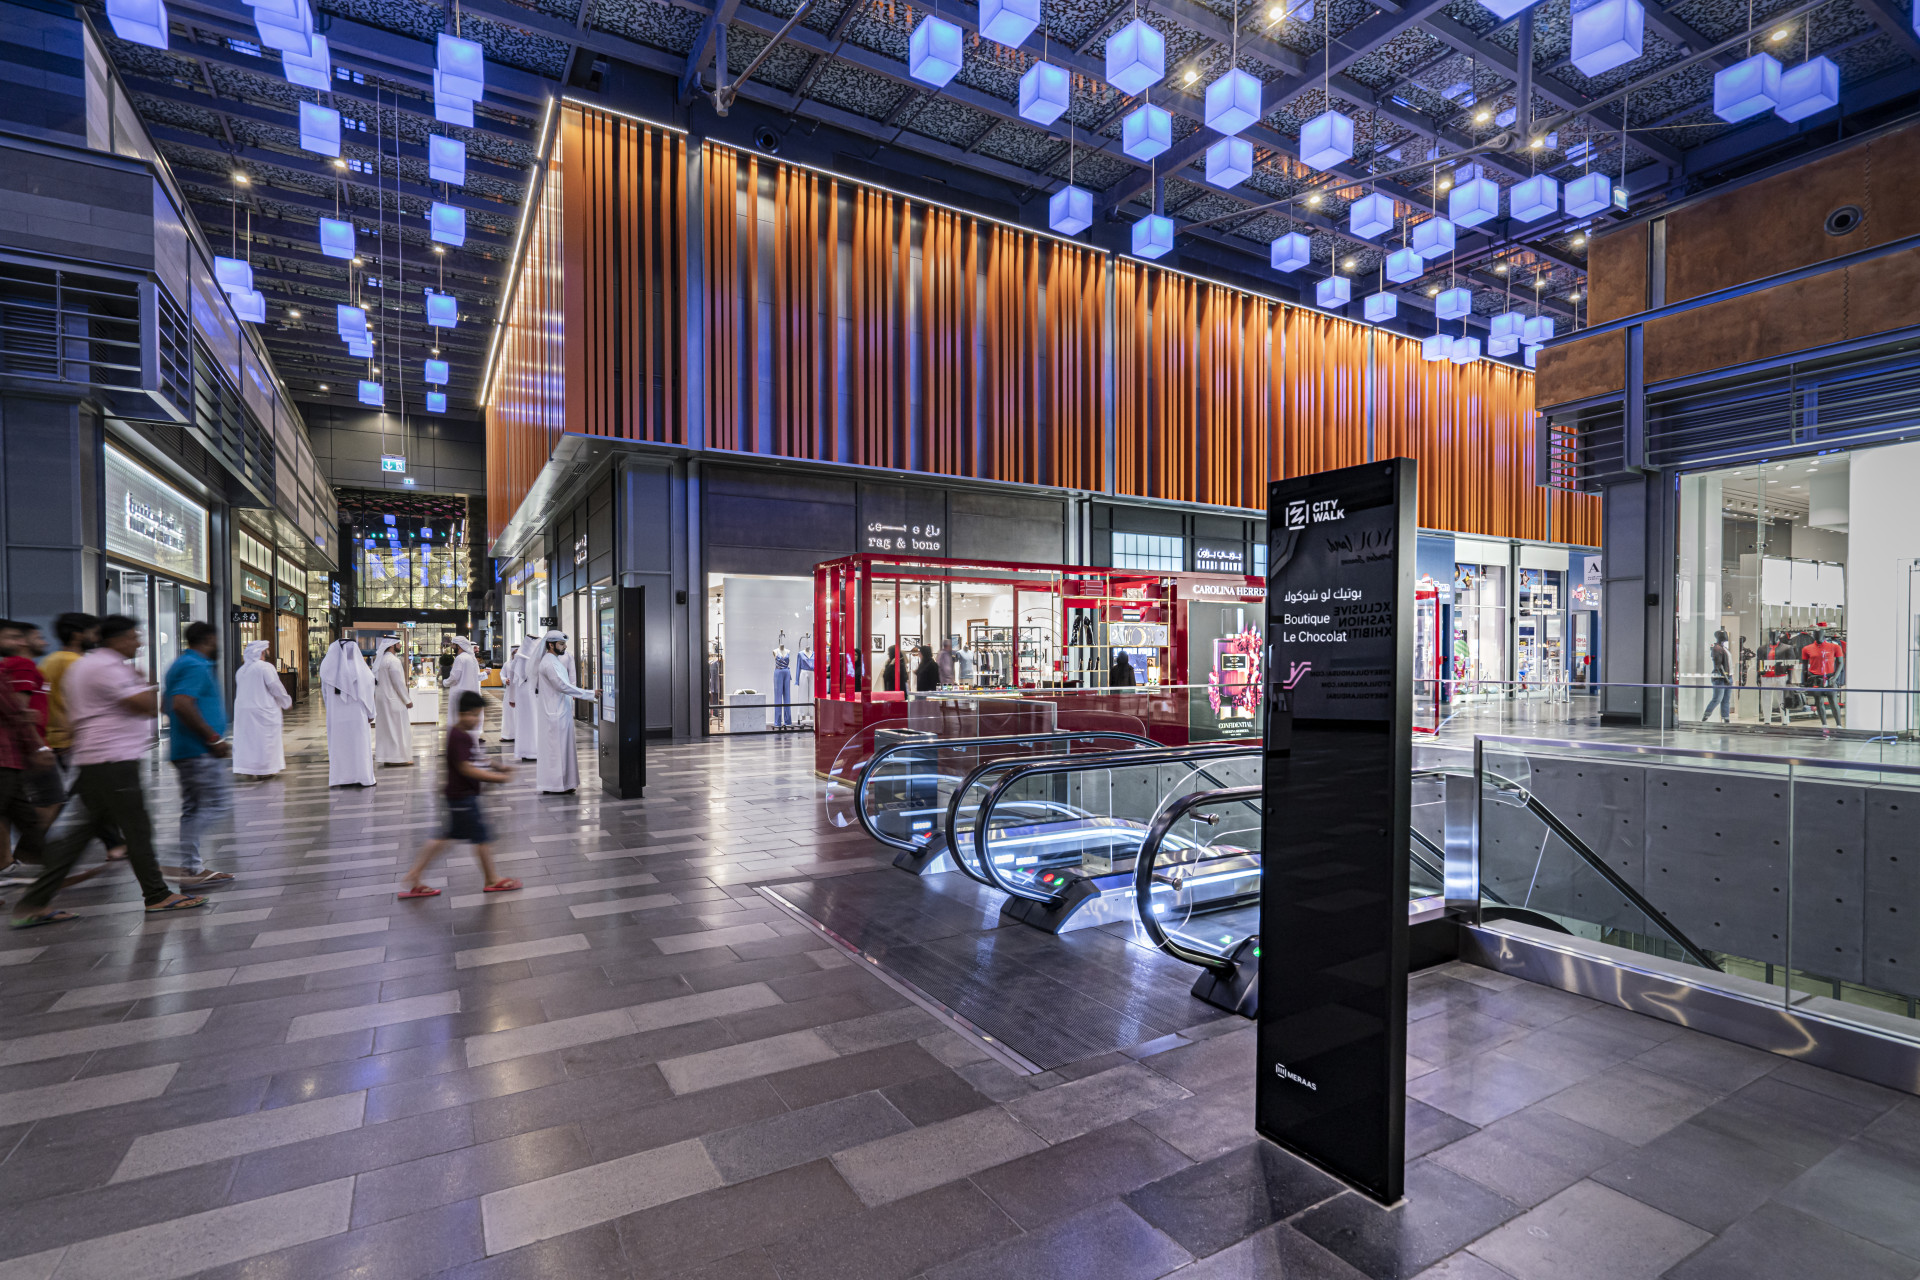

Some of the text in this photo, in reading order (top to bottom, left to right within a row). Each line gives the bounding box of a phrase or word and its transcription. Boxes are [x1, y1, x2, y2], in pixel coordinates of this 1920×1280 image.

[1312, 499, 1338, 512] CITY
[1313, 509, 1345, 523] WALK
[868, 537, 941, 551] rag & bone
[1192, 584, 1267, 596] CAROLINA HERRE
[1284, 587, 1362, 603] بوتيك لو شوكولا
[1284, 613, 1331, 626] Boutique
[1283, 631, 1347, 642] Le Chocolat
[1287, 1071, 1317, 1091] MERAAS
